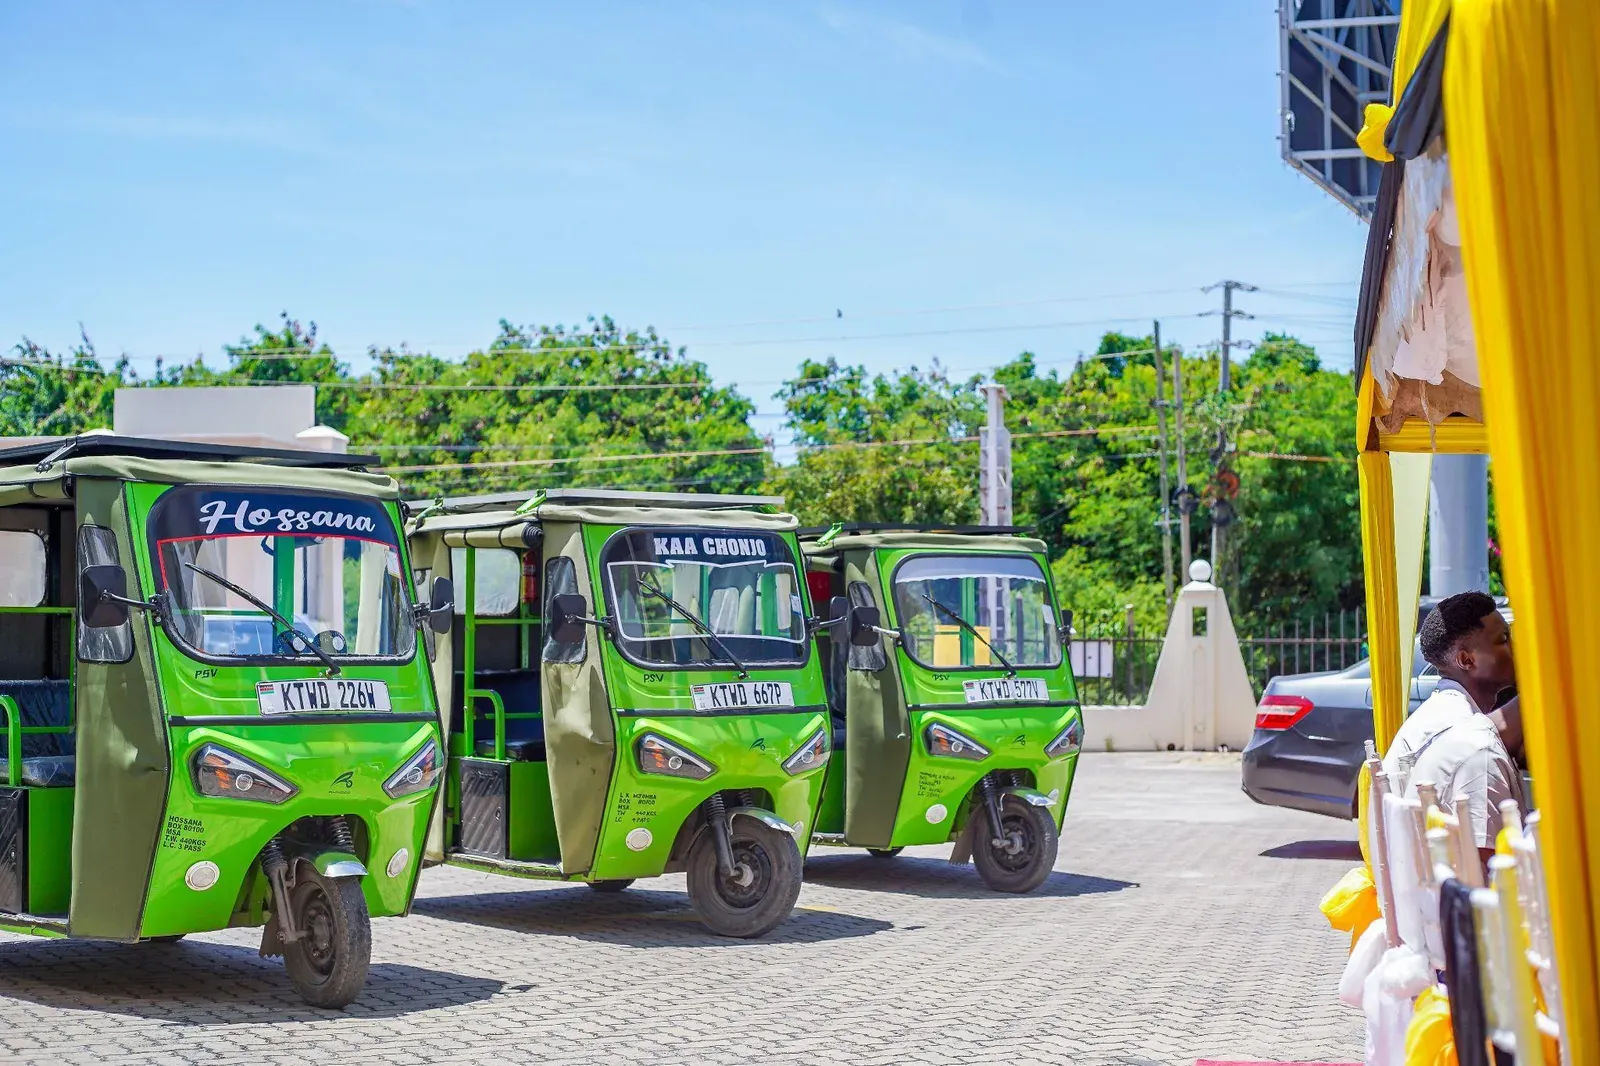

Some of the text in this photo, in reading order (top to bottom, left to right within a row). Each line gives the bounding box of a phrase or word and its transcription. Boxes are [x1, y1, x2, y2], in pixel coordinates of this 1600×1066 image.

[199, 500, 376, 534] Hossana
[653, 537, 767, 556] KAA CHONJO
[195, 669, 218, 679] PSV
[281, 680, 376, 710] KTWD 226W
[709, 682, 782, 707] KTWD 667P
[979, 680, 1039, 700] KTWD 577V
[167, 821, 205, 833] BOX 80100
[169, 815, 203, 827] HOSSANA
[166, 828, 181, 836] MSA
[184, 844, 202, 852] PASS
